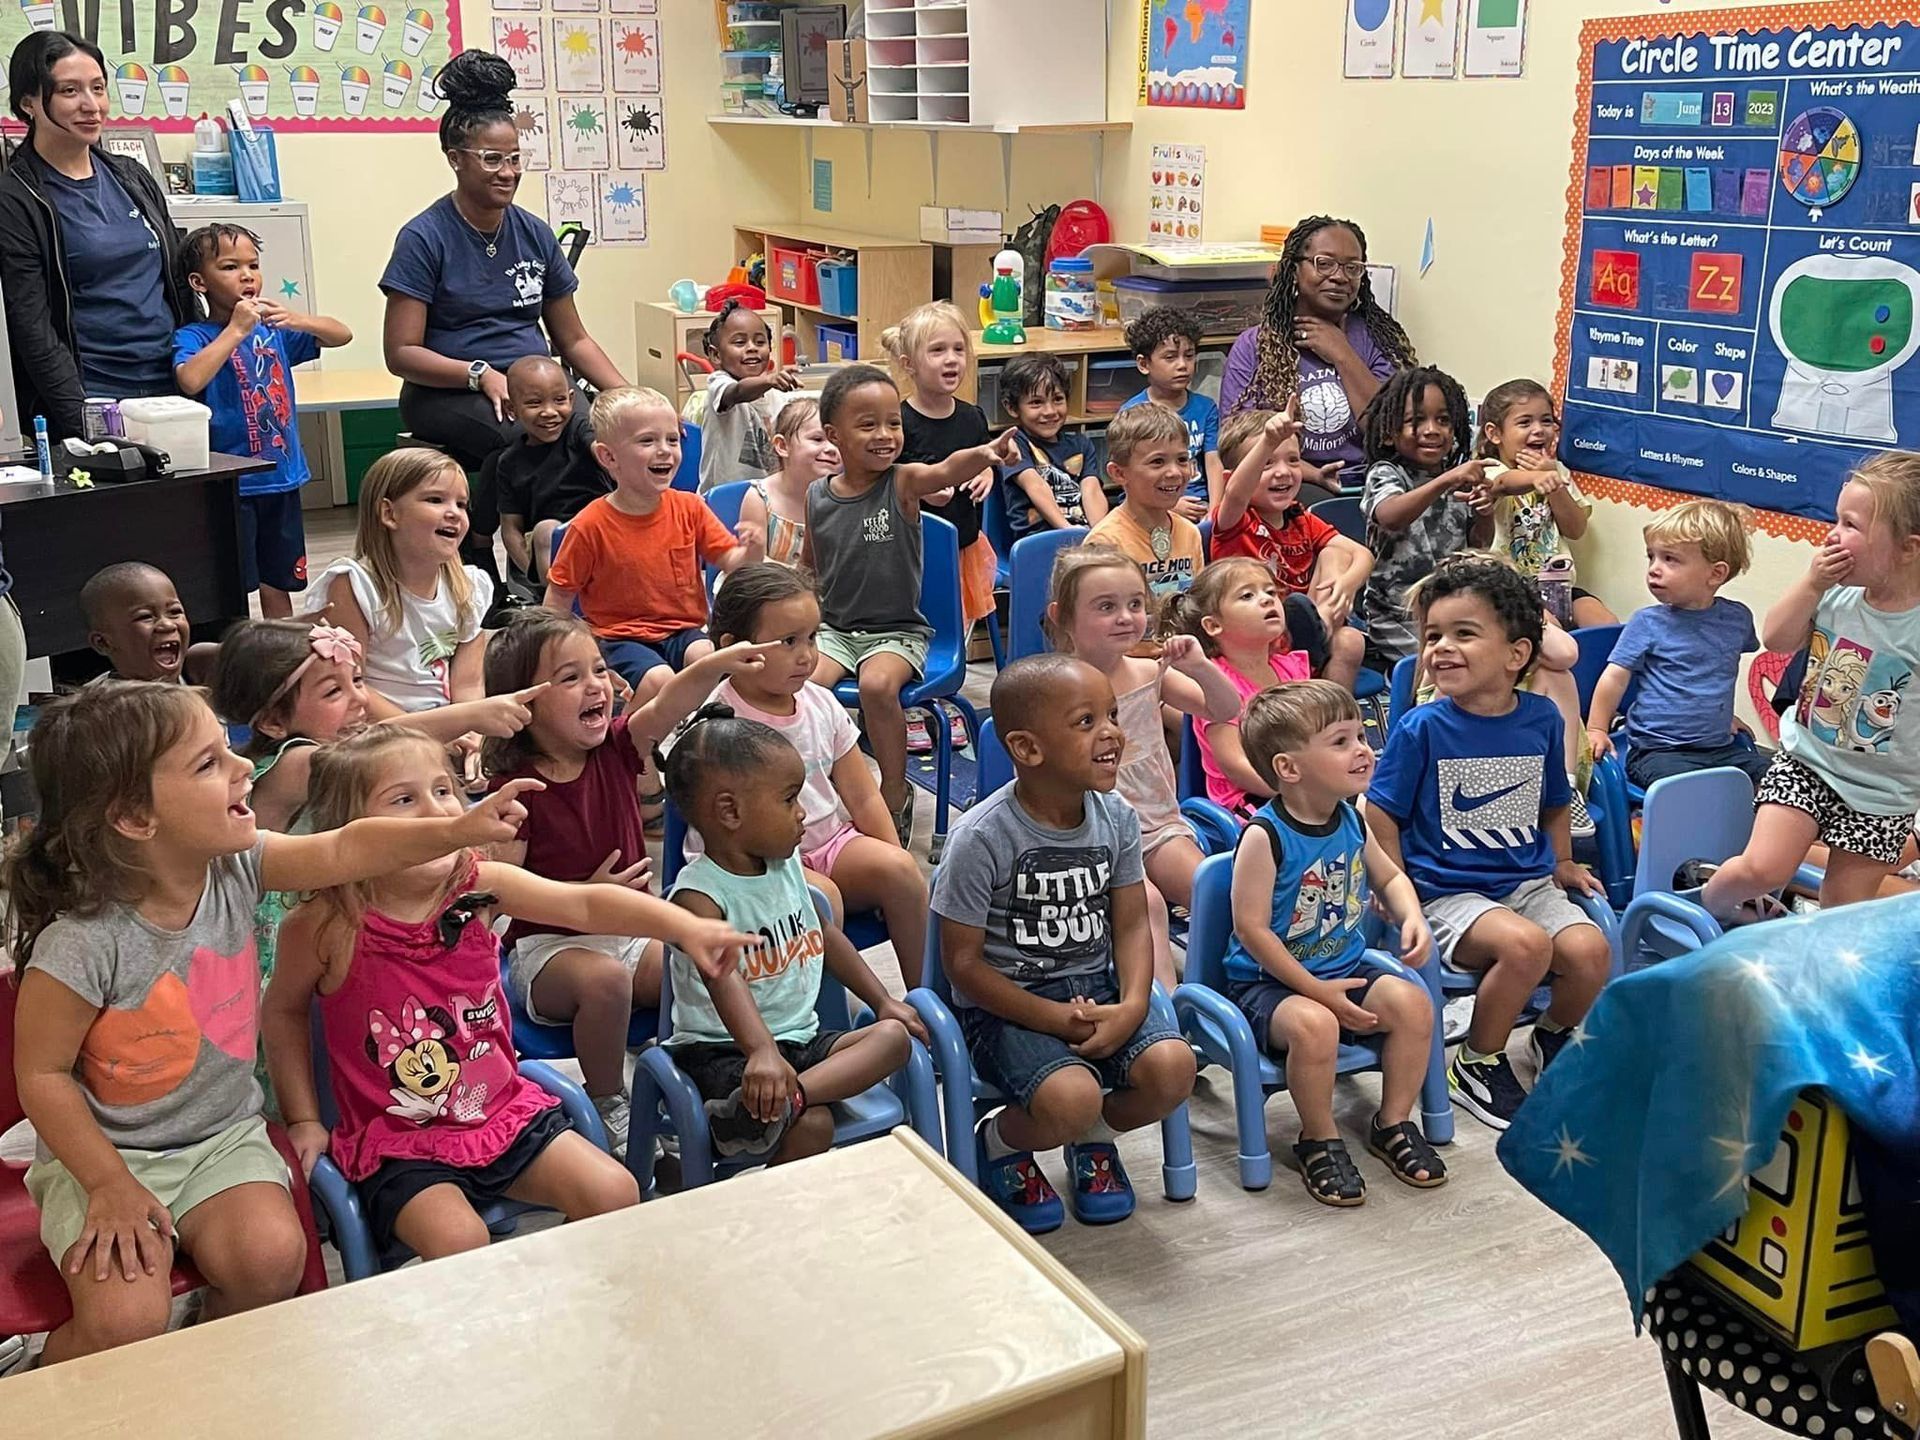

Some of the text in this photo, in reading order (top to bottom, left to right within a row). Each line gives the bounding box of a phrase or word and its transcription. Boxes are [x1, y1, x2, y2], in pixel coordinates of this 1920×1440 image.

[61, 0, 304, 65] VIBES
[1138, 0, 1149, 98] The Continents
[1621, 31, 1902, 73] Circle Time Center
[624, 68, 647, 76] orange
[1810, 80, 1853, 96] What's
[1856, 80, 1876, 95] the
[1597, 104, 1634, 119] Today is
[1677, 101, 1701, 117] June
[1716, 103, 1730, 115] 13
[1748, 103, 1774, 115] 2023
[111, 141, 143, 152] TEACH
[1153, 146, 1181, 159] Fruits
[1633, 146, 1725, 163] Days of the Week
[1624, 229, 1719, 249] What's the Letter?
[1818, 235, 1893, 253] Let's Count
[1696, 265, 1735, 300] Zz
[1589, 328, 1645, 347] Rhyme Time
[1667, 337, 1699, 354] Color
[1714, 343, 1747, 361] Shape
[1573, 437, 1607, 452] Calendar
[1640, 448, 1664, 464] Letters
[1672, 456, 1704, 469] Rhymes
[1732, 462, 1757, 477] Colors
[1766, 468, 1798, 484] Shapes
[1168, 558, 1193, 571] MOD
[1016, 861, 1110, 901] LITTLE
[1012, 908, 1105, 947] LOUD
